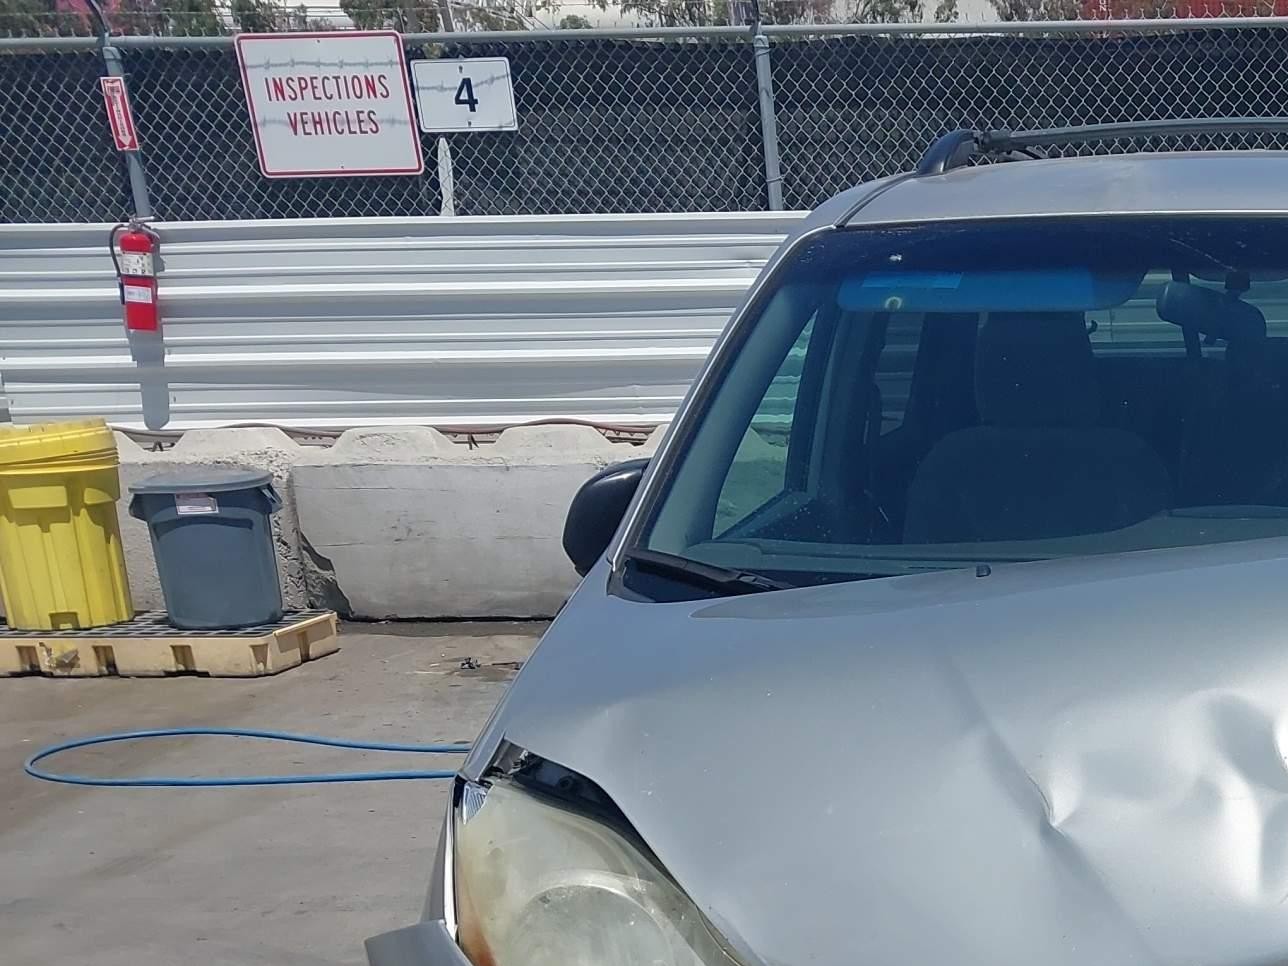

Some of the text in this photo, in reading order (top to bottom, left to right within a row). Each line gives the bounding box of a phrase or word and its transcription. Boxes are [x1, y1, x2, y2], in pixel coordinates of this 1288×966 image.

[264, 74, 390, 102] INSPECTIONS
[454, 77, 479, 113] 4
[287, 110, 380, 136] VEHICLES
